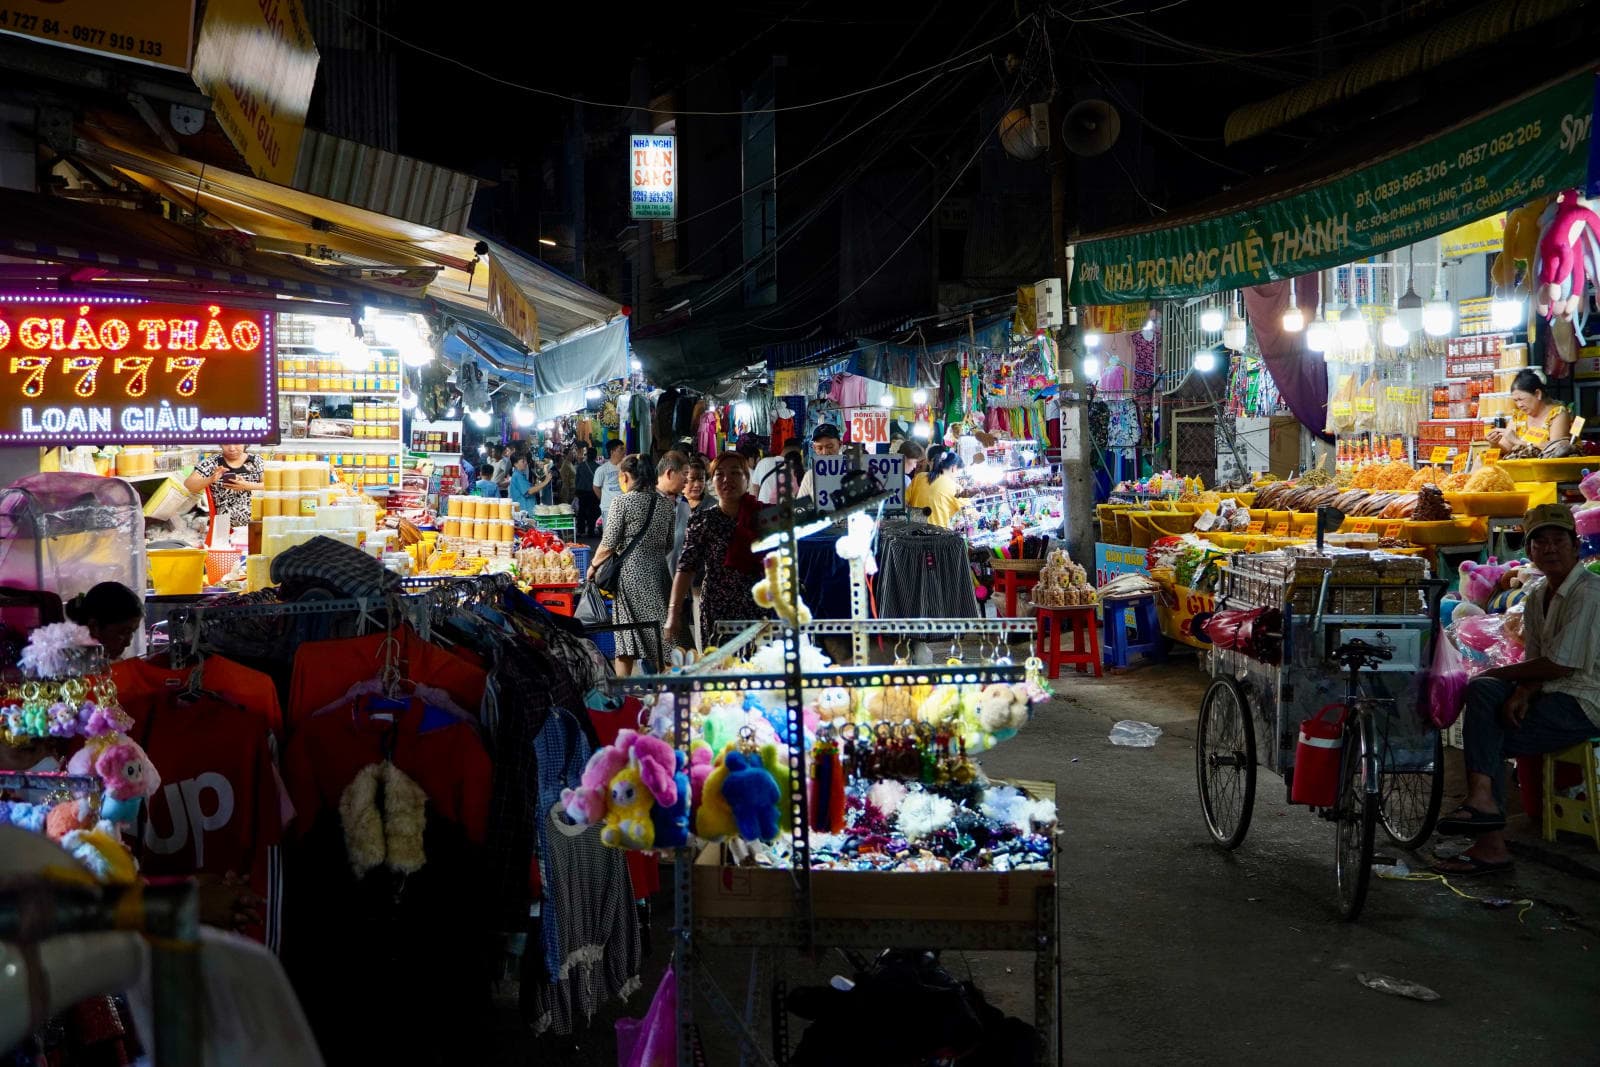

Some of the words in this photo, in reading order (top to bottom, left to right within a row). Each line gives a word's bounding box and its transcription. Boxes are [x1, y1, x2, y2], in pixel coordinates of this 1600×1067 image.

[13, 11, 39, 31] 727
[42, 19, 60, 35] 84
[72, 24, 106, 45] 0977
[110, 33, 135, 51] 919
[138, 39, 163, 57] 133
[1489, 132, 1515, 157] 062
[1517, 119, 1542, 146] 205
[1104, 254, 1134, 292] NHÀ
[1136, 256, 1167, 294] TRỌ
[1170, 247, 1220, 288] NGỌC
[1270, 212, 1349, 265] THÀNH
[18, 305, 130, 351] GIÁO
[137, 305, 261, 351] THẢO
[21, 406, 112, 433] LOAN
[120, 399, 200, 432] GIÀU
[852, 417, 888, 443] 39K
[130, 770, 235, 869] up
